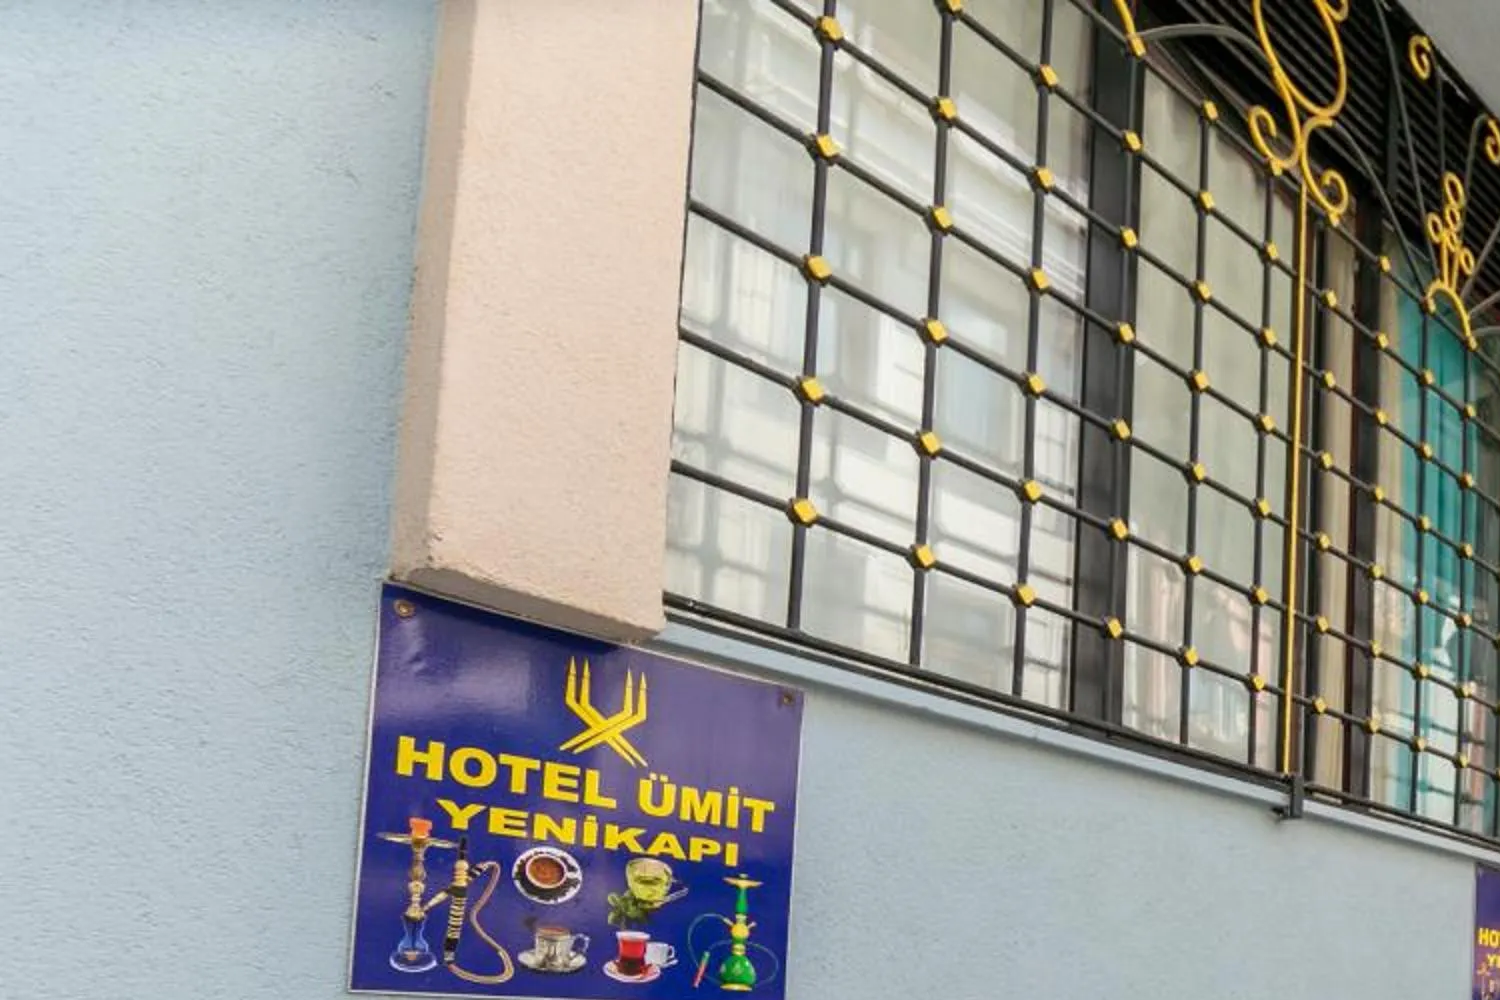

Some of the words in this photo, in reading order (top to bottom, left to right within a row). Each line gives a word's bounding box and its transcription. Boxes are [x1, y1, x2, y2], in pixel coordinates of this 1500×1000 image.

[395, 735, 617, 810] HOTEL
[638, 773, 775, 834] ÜMİT
[436, 799, 739, 867] YENİKAPI
